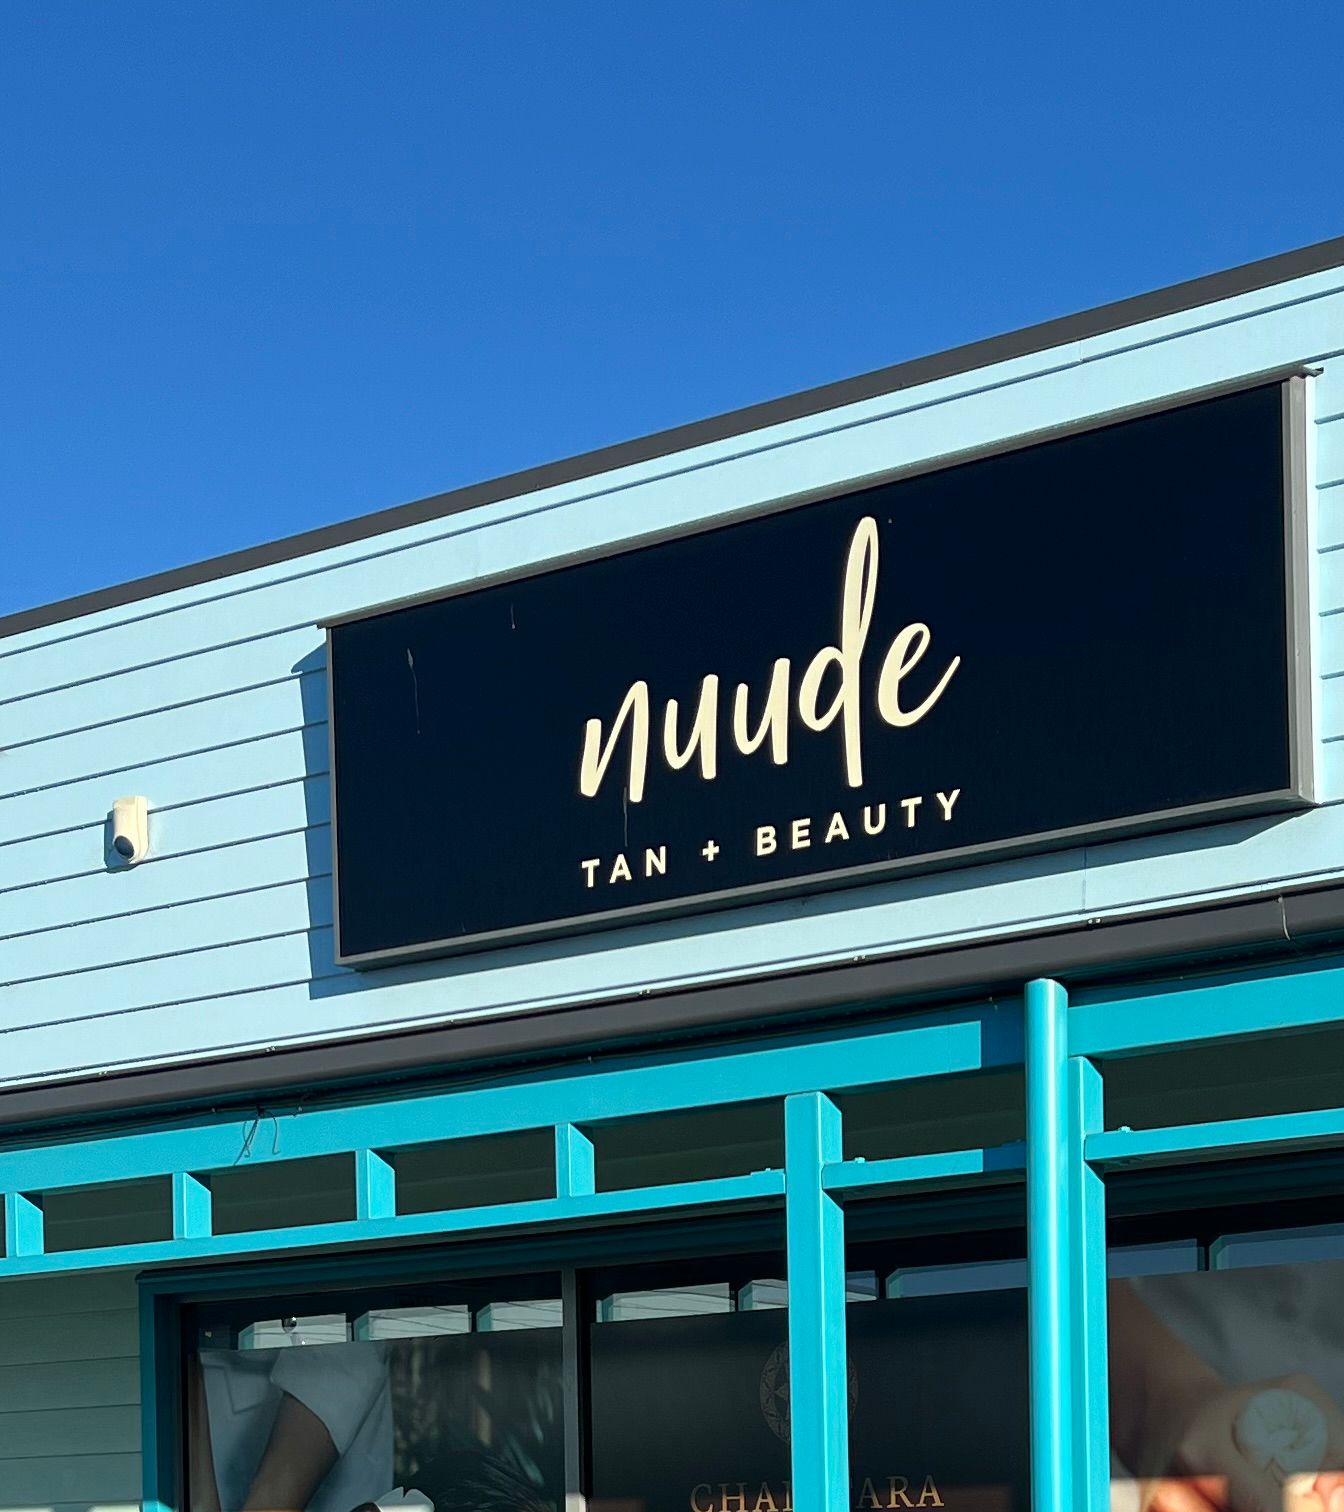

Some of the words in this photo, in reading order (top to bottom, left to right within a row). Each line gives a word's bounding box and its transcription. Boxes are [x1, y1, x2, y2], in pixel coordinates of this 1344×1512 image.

[580, 516, 961, 802] nuude
[581, 846, 667, 888] TAN
[702, 840, 721, 862] +
[756, 789, 961, 857] BEAUTY
